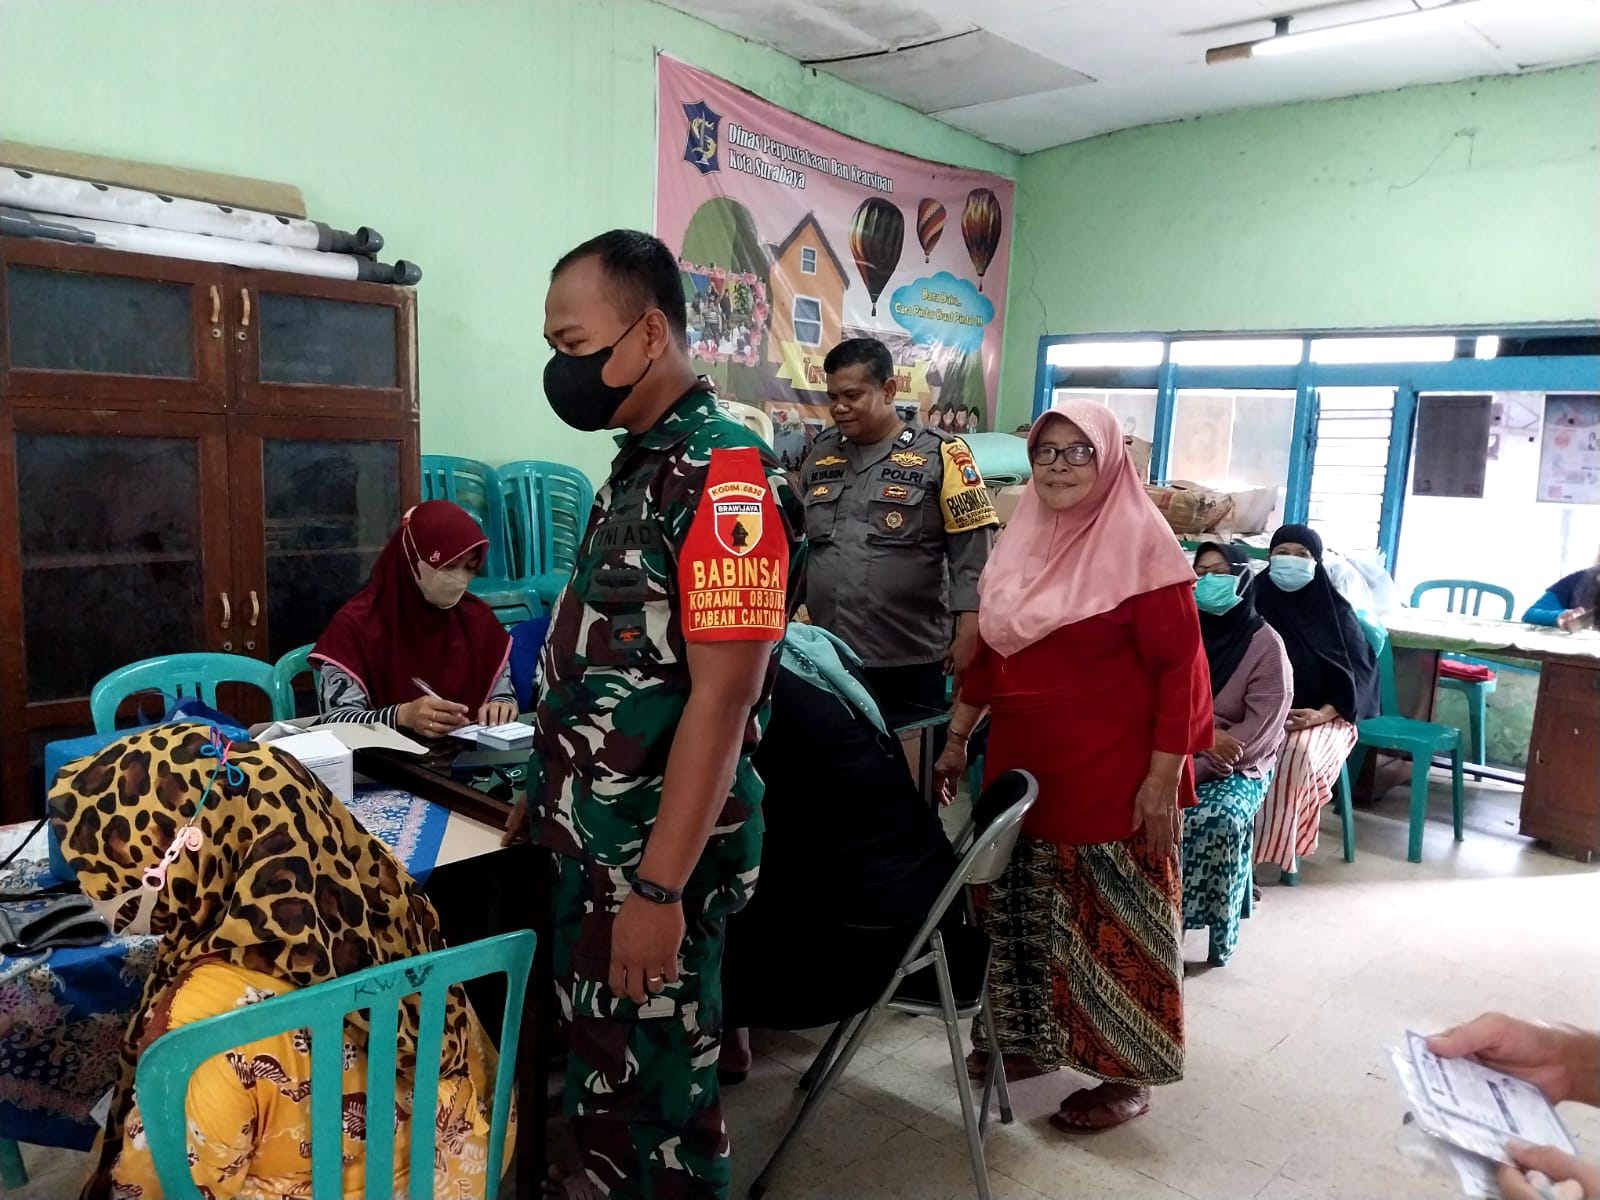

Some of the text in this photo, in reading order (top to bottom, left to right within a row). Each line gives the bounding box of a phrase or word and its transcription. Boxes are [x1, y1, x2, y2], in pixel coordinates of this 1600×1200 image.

[728, 123, 893, 193] Dinas Perpustakaan Dan Kearsipan
[729, 149, 806, 189] Kota Surabaya
[881, 467, 924, 485] POLRI
[711, 484, 740, 497] KODIM
[717, 504, 759, 513] BRAWIJAYA
[693, 557, 780, 589] BABINSA
[689, 590, 743, 611] KORAMIL
[694, 608, 780, 627] PABEAN CANTIAN
